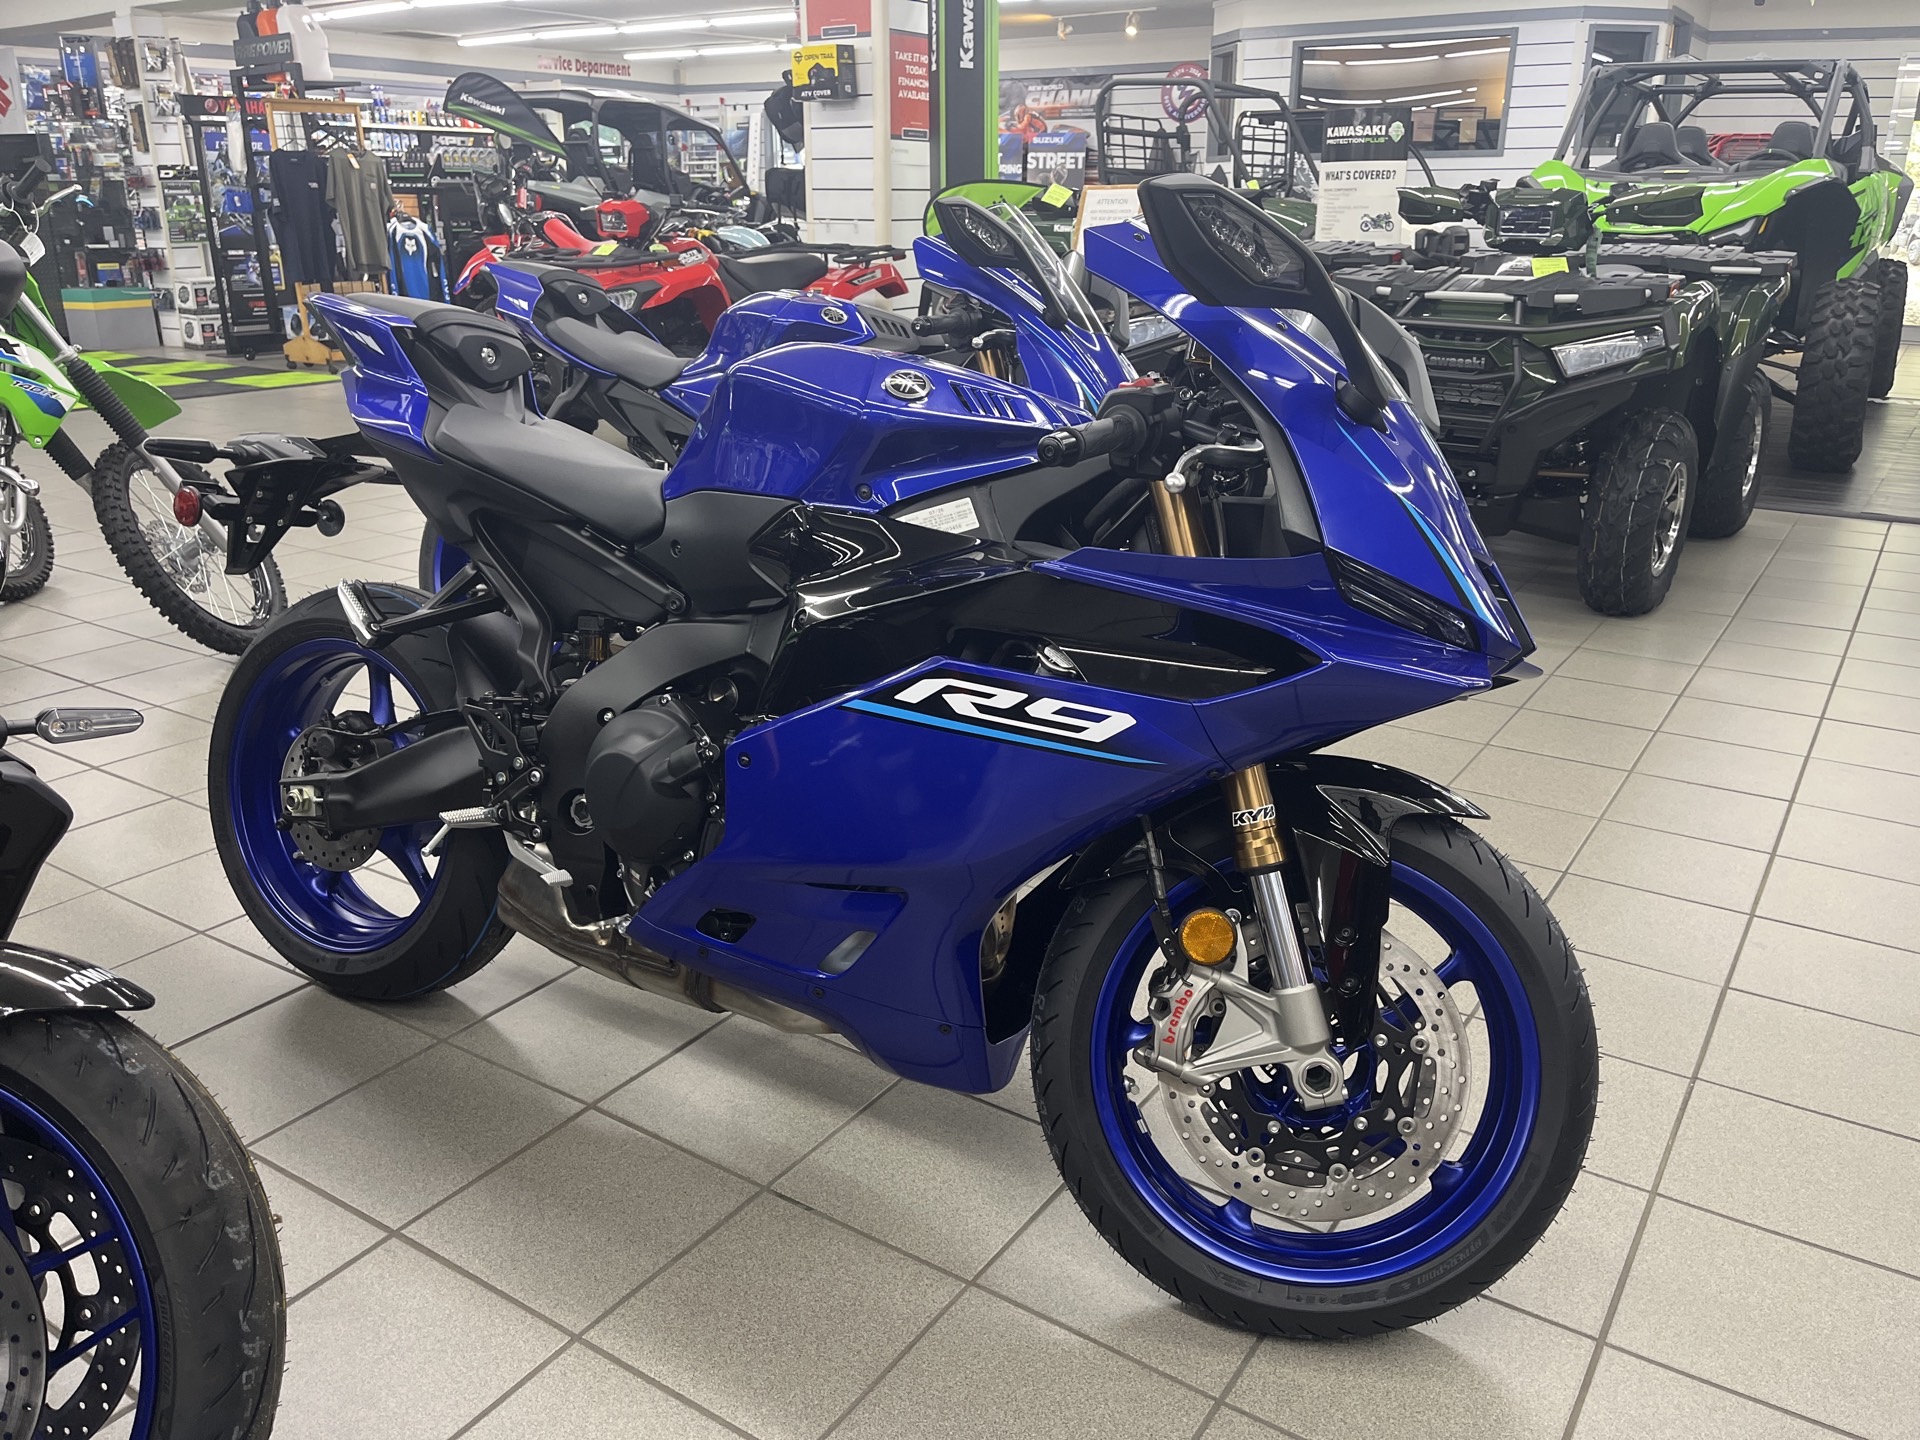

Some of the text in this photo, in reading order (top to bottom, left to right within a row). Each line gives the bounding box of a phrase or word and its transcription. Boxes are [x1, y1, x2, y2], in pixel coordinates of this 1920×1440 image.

[894, 51, 929, 64] TAKE IT HO
[575, 59, 631, 77] Department
[905, 65, 927, 76] TODAY.
[898, 77, 929, 88] FINANCIN
[813, 89, 831, 97] COVER
[460, 92, 505, 116] Kawasaki
[1326, 124, 1387, 138] KAWASAKI
[1027, 152, 1086, 169] STREET
[1325, 170, 1397, 181] WHAT'S COVERED?
[894, 678, 1137, 743] R9
[1232, 804, 1276, 827] KYB
[1162, 989, 1193, 1044] brembo
